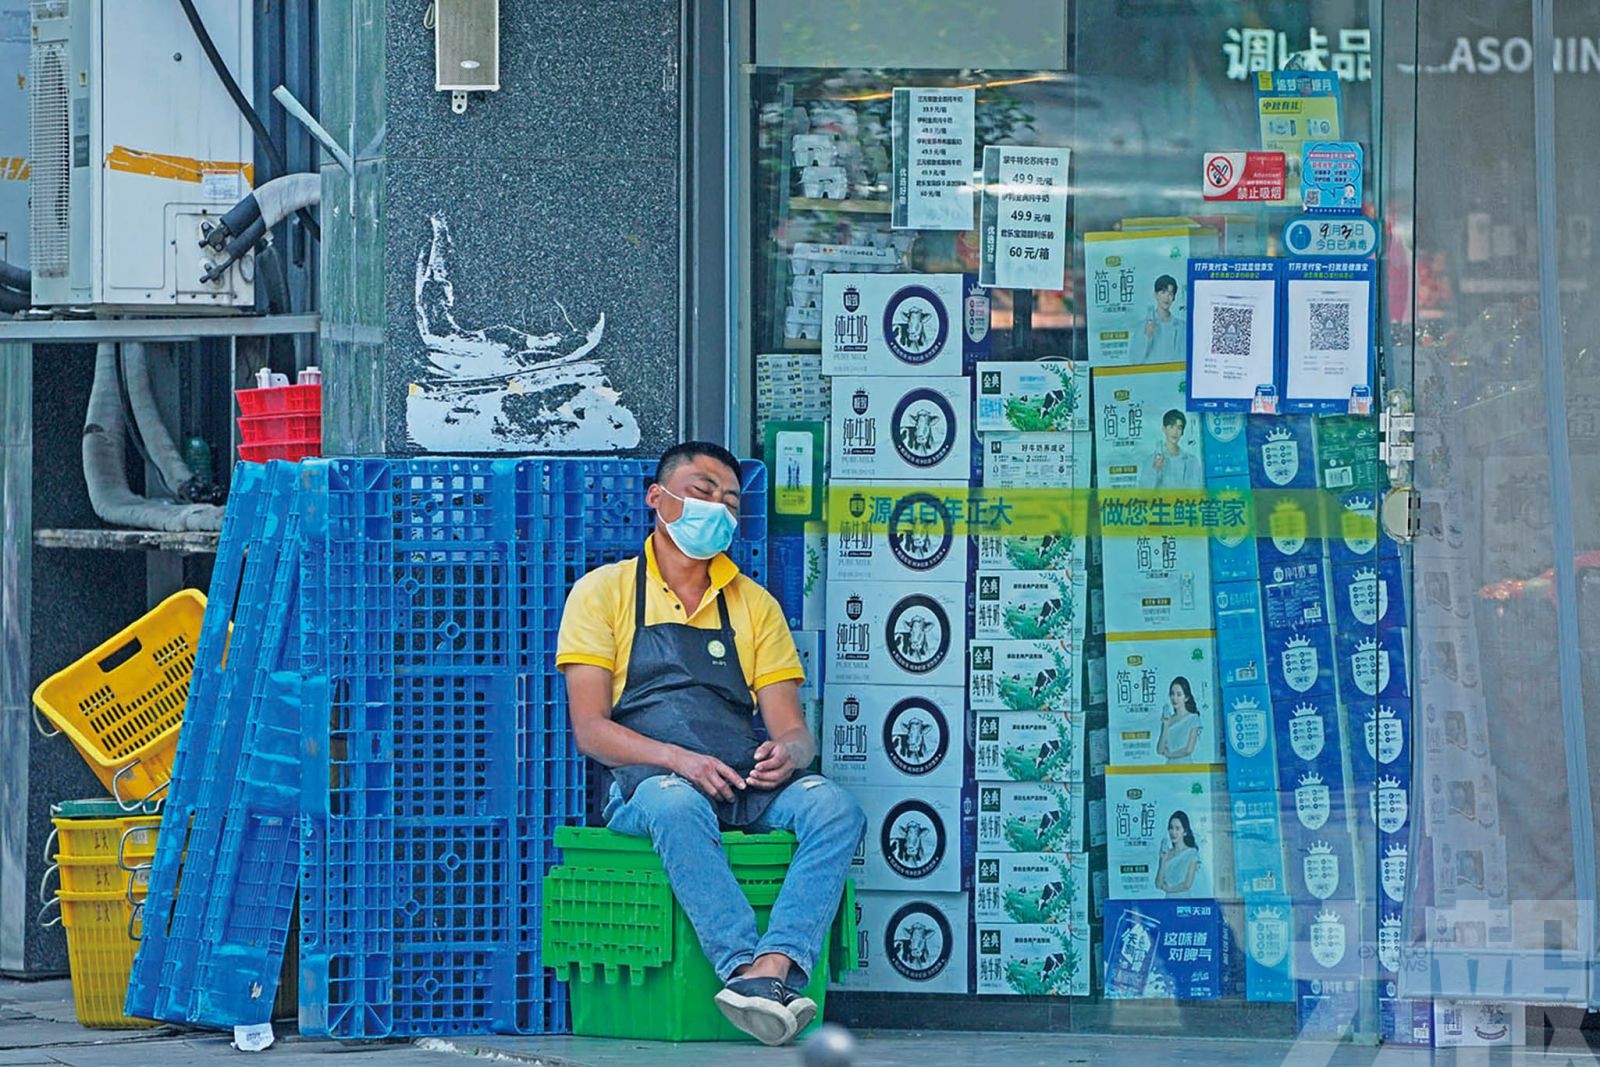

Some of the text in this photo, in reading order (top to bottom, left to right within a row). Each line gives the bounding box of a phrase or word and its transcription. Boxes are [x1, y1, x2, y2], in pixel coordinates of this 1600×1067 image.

[1238, 187, 1281, 200] 禁止吸烟
[1011, 211, 1051, 222] 49.9 元/箱
[1316, 239, 1367, 250] 今日已消毒
[1009, 247, 1049, 260] 60 元/箱
[835, 315, 868, 343] 纯牛奶
[983, 374, 999, 388] 金典
[843, 418, 876, 447] 纯牛奶
[868, 496, 1013, 525] 源自百年正大
[1101, 498, 1246, 527] 做您生鲜管家
[840, 521, 872, 549] 纯牛奶
[981, 579, 998, 594] 金典
[837, 623, 870, 652] 纯牛奶
[974, 648, 991, 663] 金典
[980, 720, 998, 734] 金典
[833, 725, 867, 753] 纯牛奶
[983, 791, 999, 805] 金典
[980, 862, 998, 876] 金典
[982, 933, 999, 948] 金典
[1163, 932, 1207, 946] 这味道
